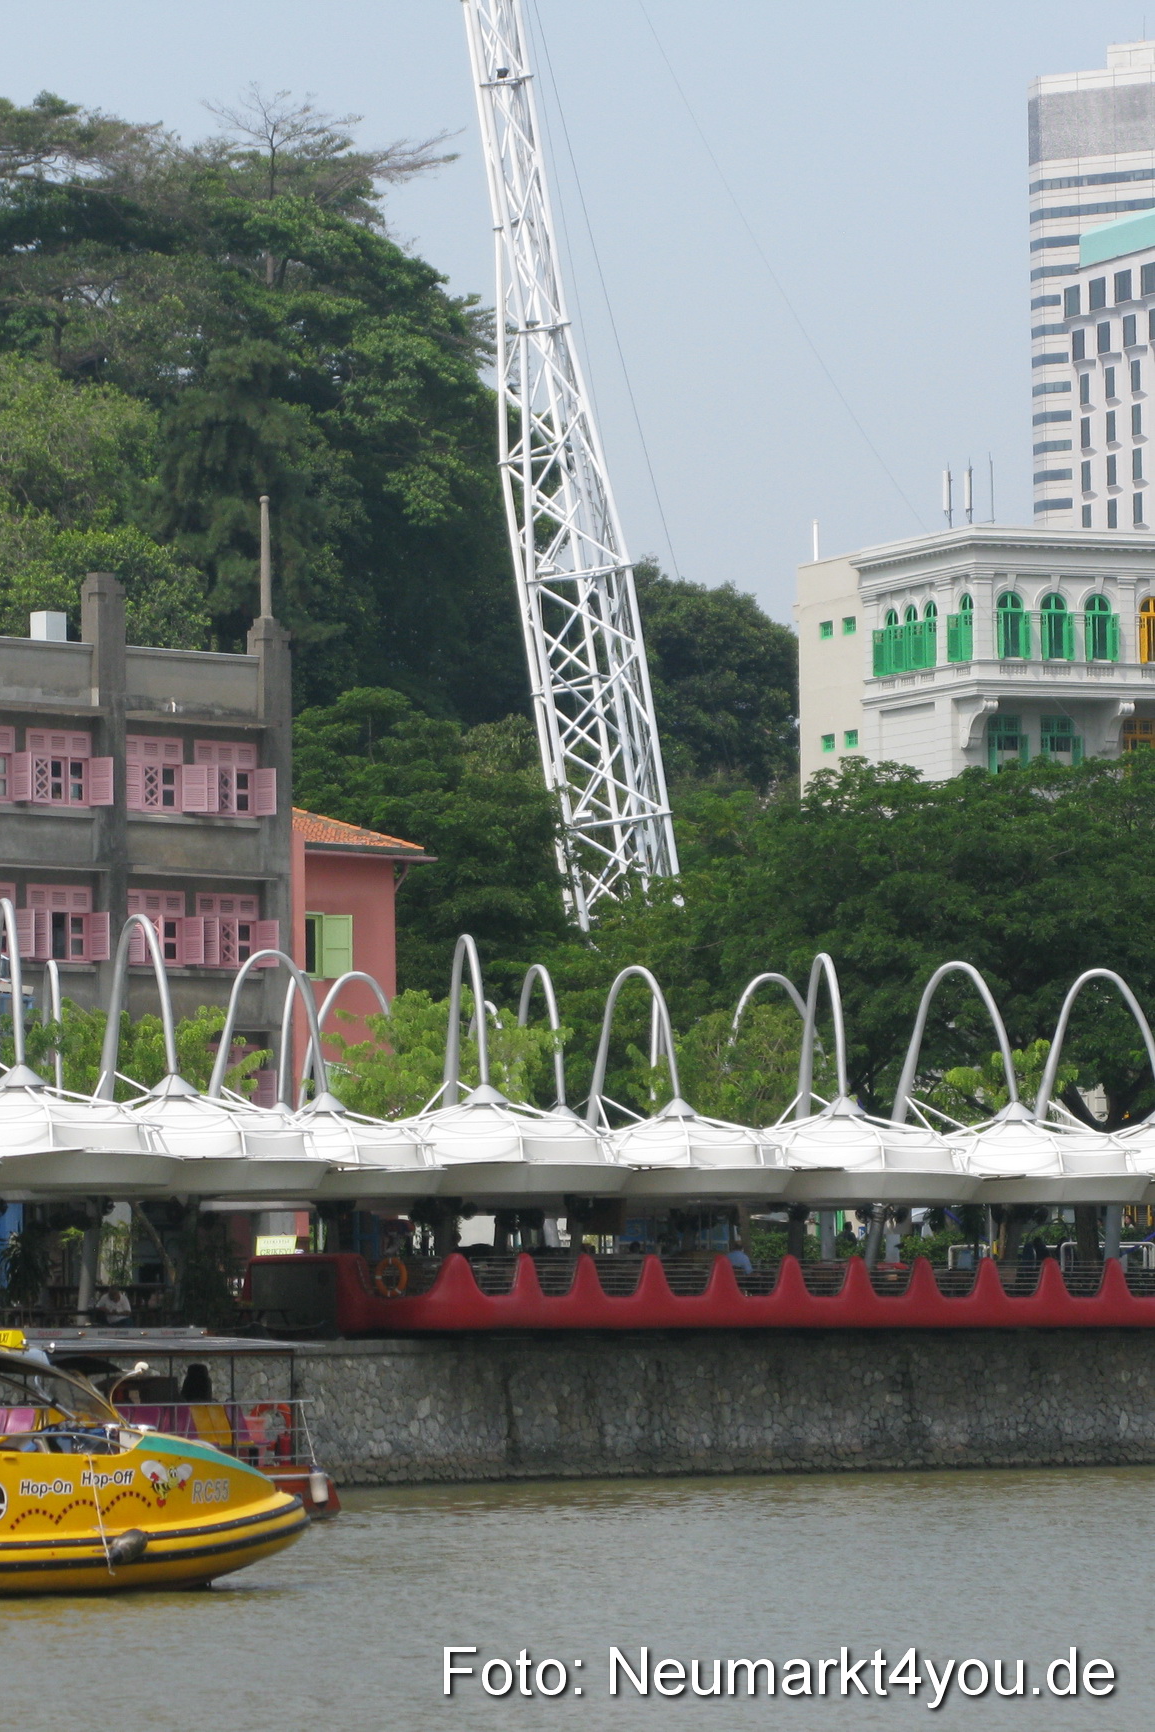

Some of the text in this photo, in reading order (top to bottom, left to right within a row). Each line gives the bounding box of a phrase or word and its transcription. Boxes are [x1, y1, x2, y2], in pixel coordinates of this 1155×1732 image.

[20, 1469, 135, 1497] Hop-On Hop-Off
[192, 1479, 229, 1504] RC55
